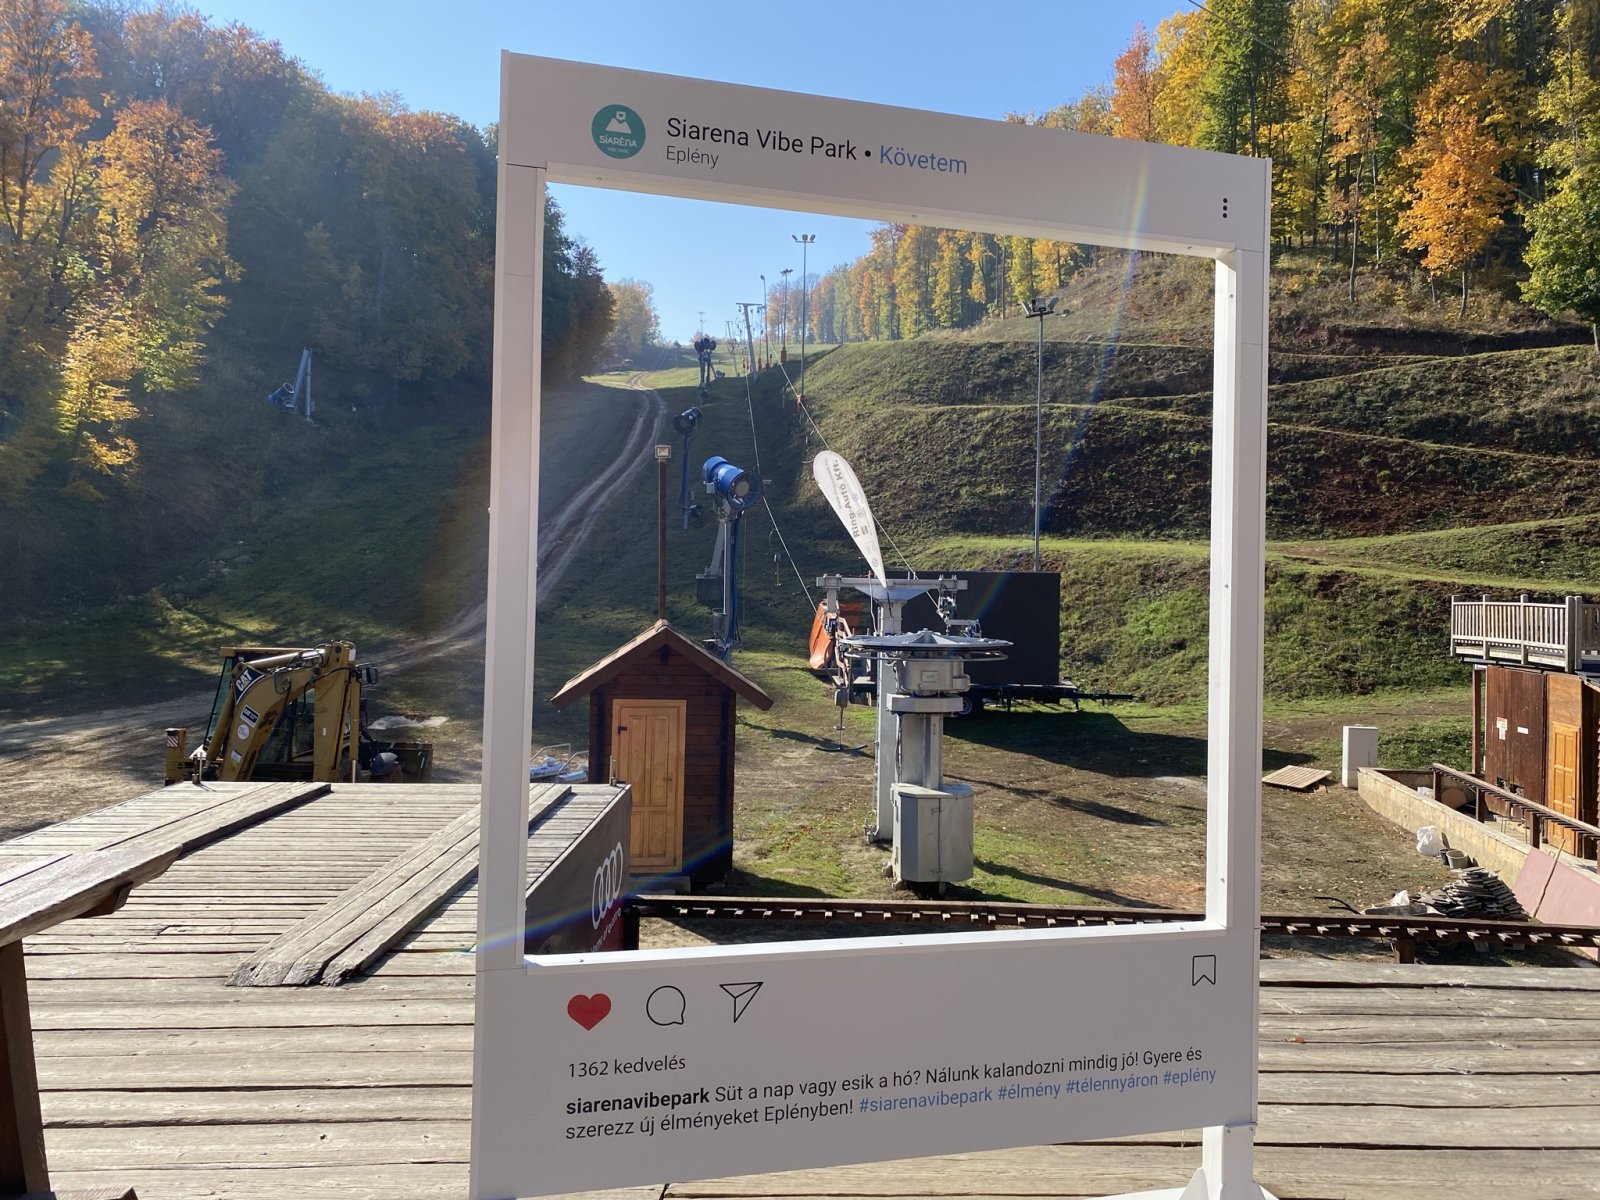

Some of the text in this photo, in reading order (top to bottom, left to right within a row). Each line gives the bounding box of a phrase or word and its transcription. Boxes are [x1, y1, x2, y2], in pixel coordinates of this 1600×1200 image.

[666, 117, 967, 174] Siarena Vibe Park Követem
[666, 144, 720, 170] Eplény
[235, 669, 253, 692] CAT
[565, 1046, 1203, 1115] siarenavibepark Süt a nap vagy esik a hó? Nálunk kalandozni mindig jó! Gyere és
[568, 1054, 686, 1078] 1362 kedvelés
[565, 1067, 1217, 1140] szerezz új élményeket Eplényben! #siarenavibepark #élmény #télennyáron #eplény
